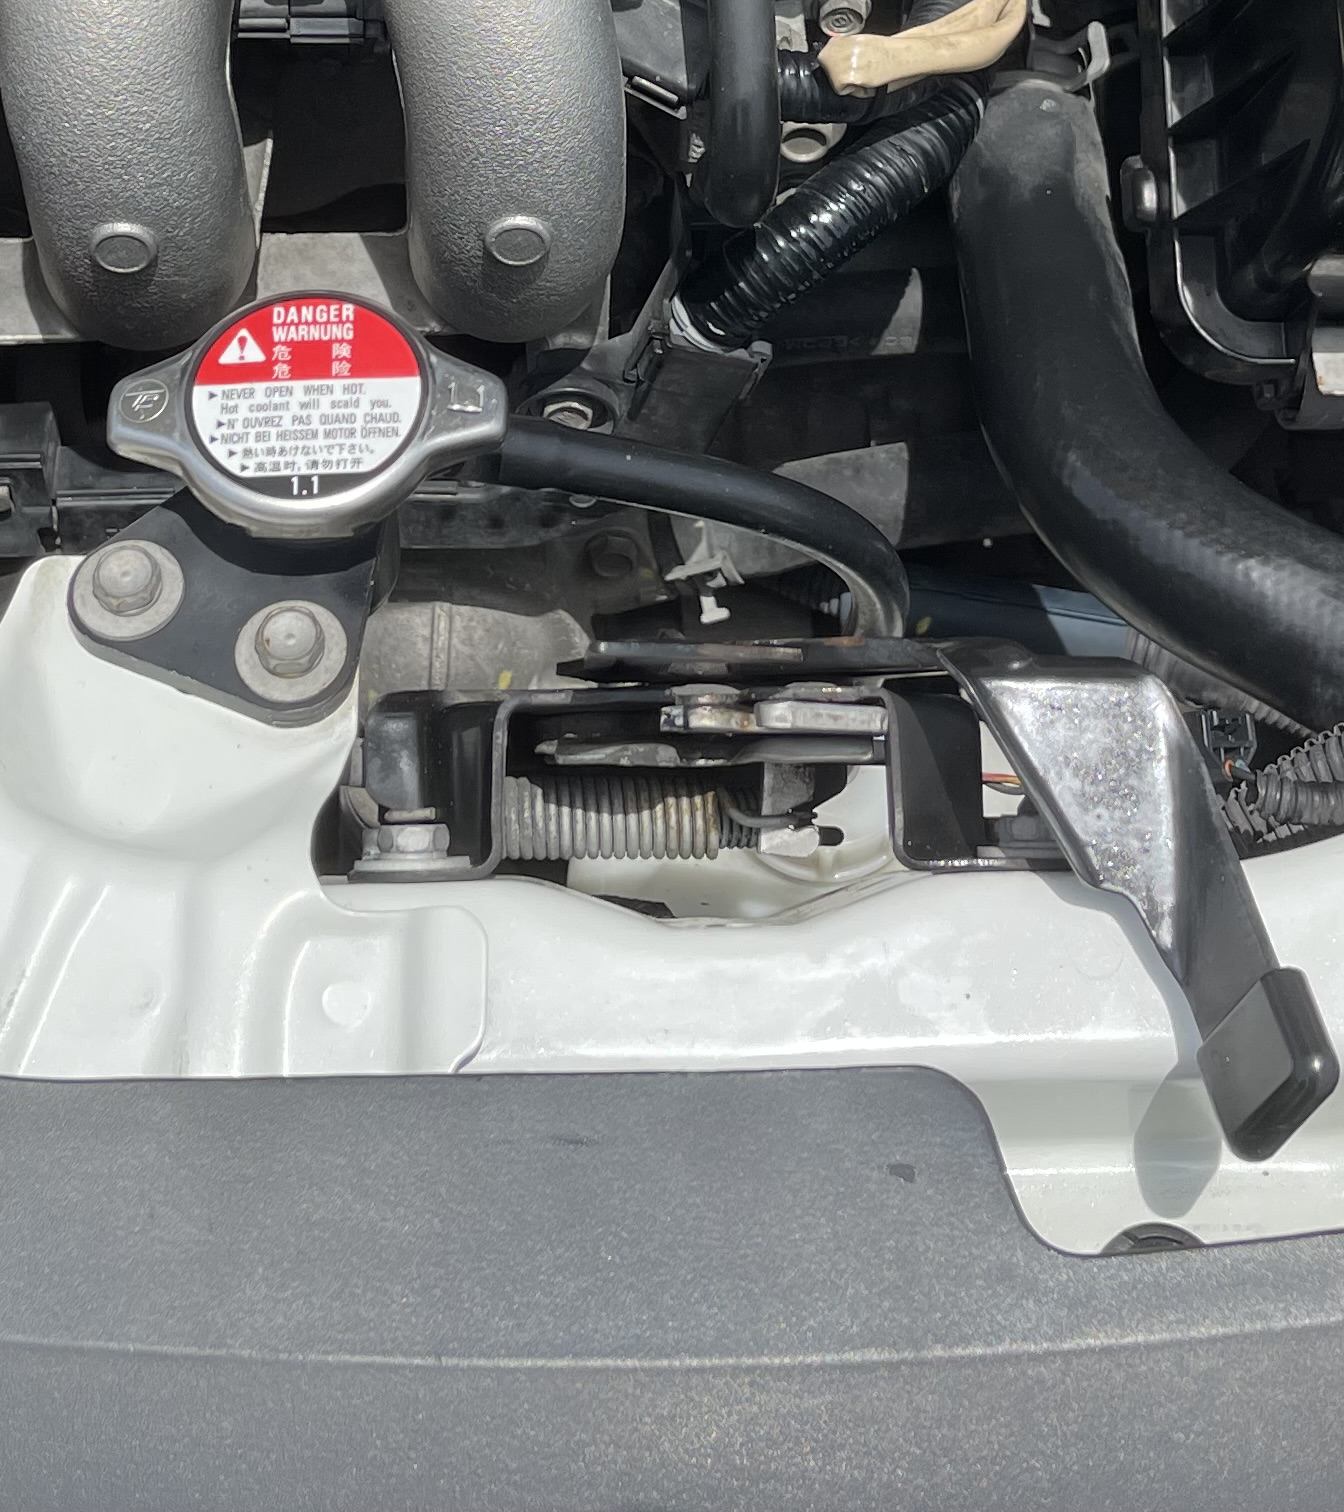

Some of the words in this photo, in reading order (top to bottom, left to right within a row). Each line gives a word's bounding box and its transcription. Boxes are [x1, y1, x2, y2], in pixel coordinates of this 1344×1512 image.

[272, 303, 355, 324] DANGER
[272, 323, 354, 342] WARNUNG
[221, 388, 255, 400] NEVER
[264, 386, 293, 398] OPEN
[303, 384, 334, 396] WHEN
[342, 383, 366, 395] HOT.
[220, 403, 239, 415] Hot
[248, 400, 290, 413] coolant
[299, 398, 320, 410] will
[330, 397, 360, 409] scald
[370, 399, 392, 410] you.
[292, 414, 312, 426] PAS
[319, 413, 356, 426] QUAND
[363, 411, 402, 424] CHAUD.
[220, 432, 251, 444] NICHT
[255, 431, 271, 443] BEI
[276, 428, 318, 441] HEISSEM
[323, 427, 357, 440] MOTOR
[291, 475, 319, 495] 1.1
